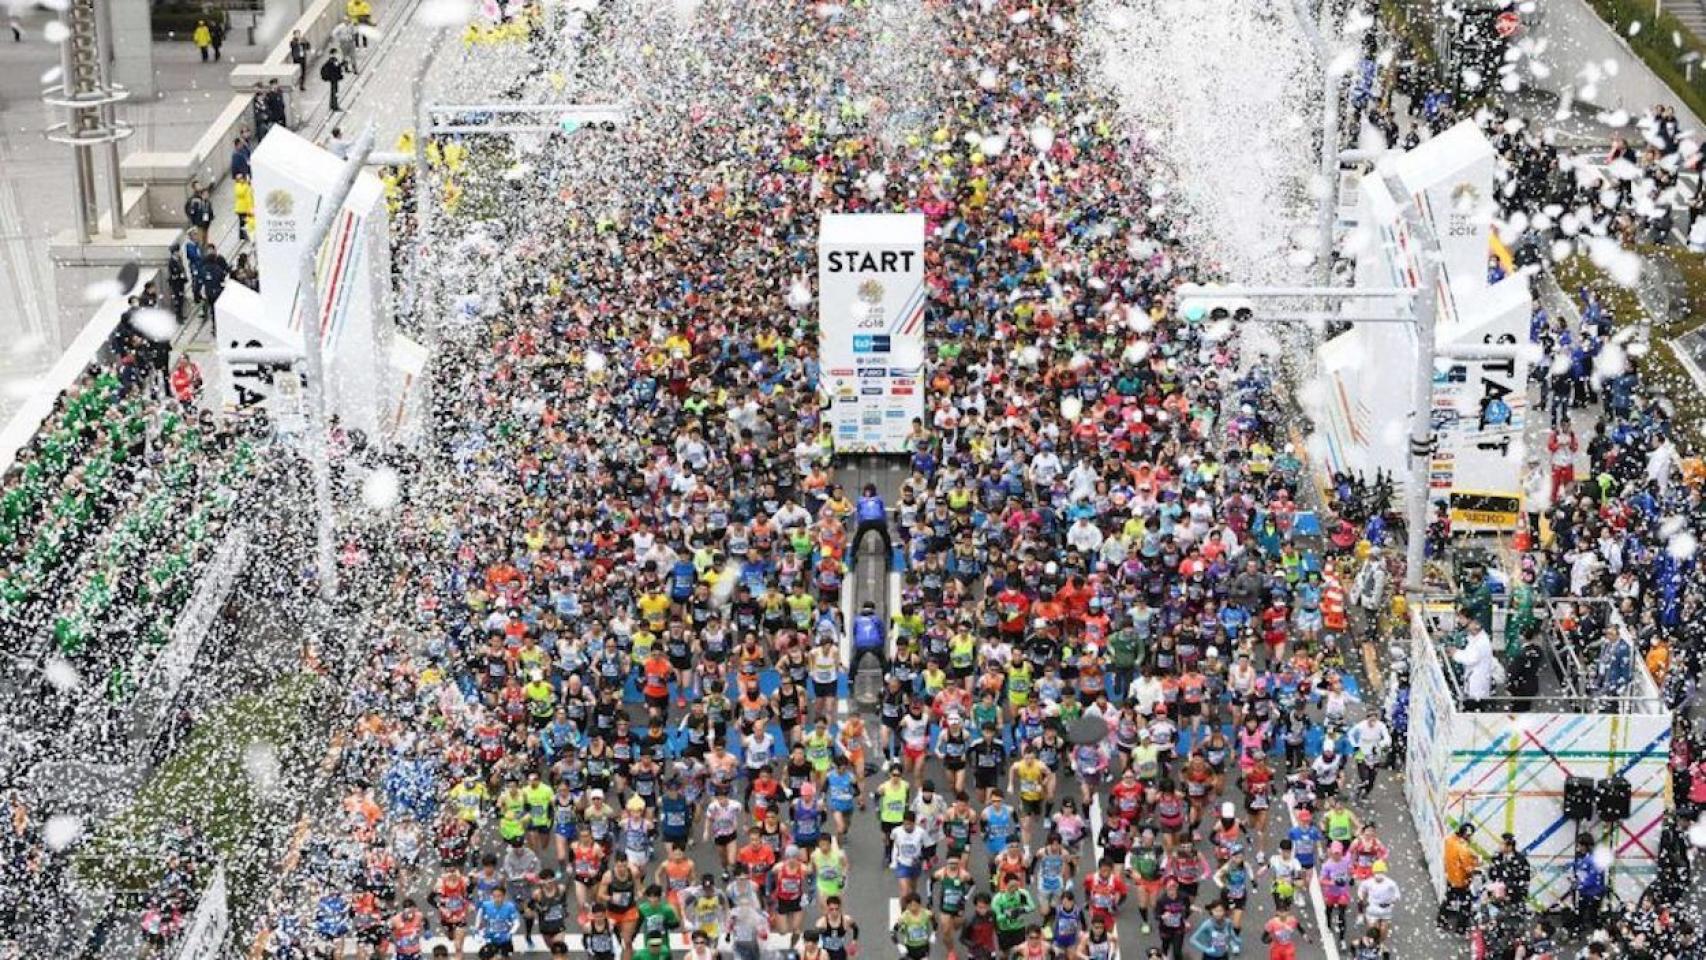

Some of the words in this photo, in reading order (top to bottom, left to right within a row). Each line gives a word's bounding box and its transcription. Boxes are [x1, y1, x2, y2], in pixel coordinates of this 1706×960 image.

[267, 232, 296, 242] 2018
[828, 251, 915, 272] START
[1463, 512, 1505, 523] SEIKO
